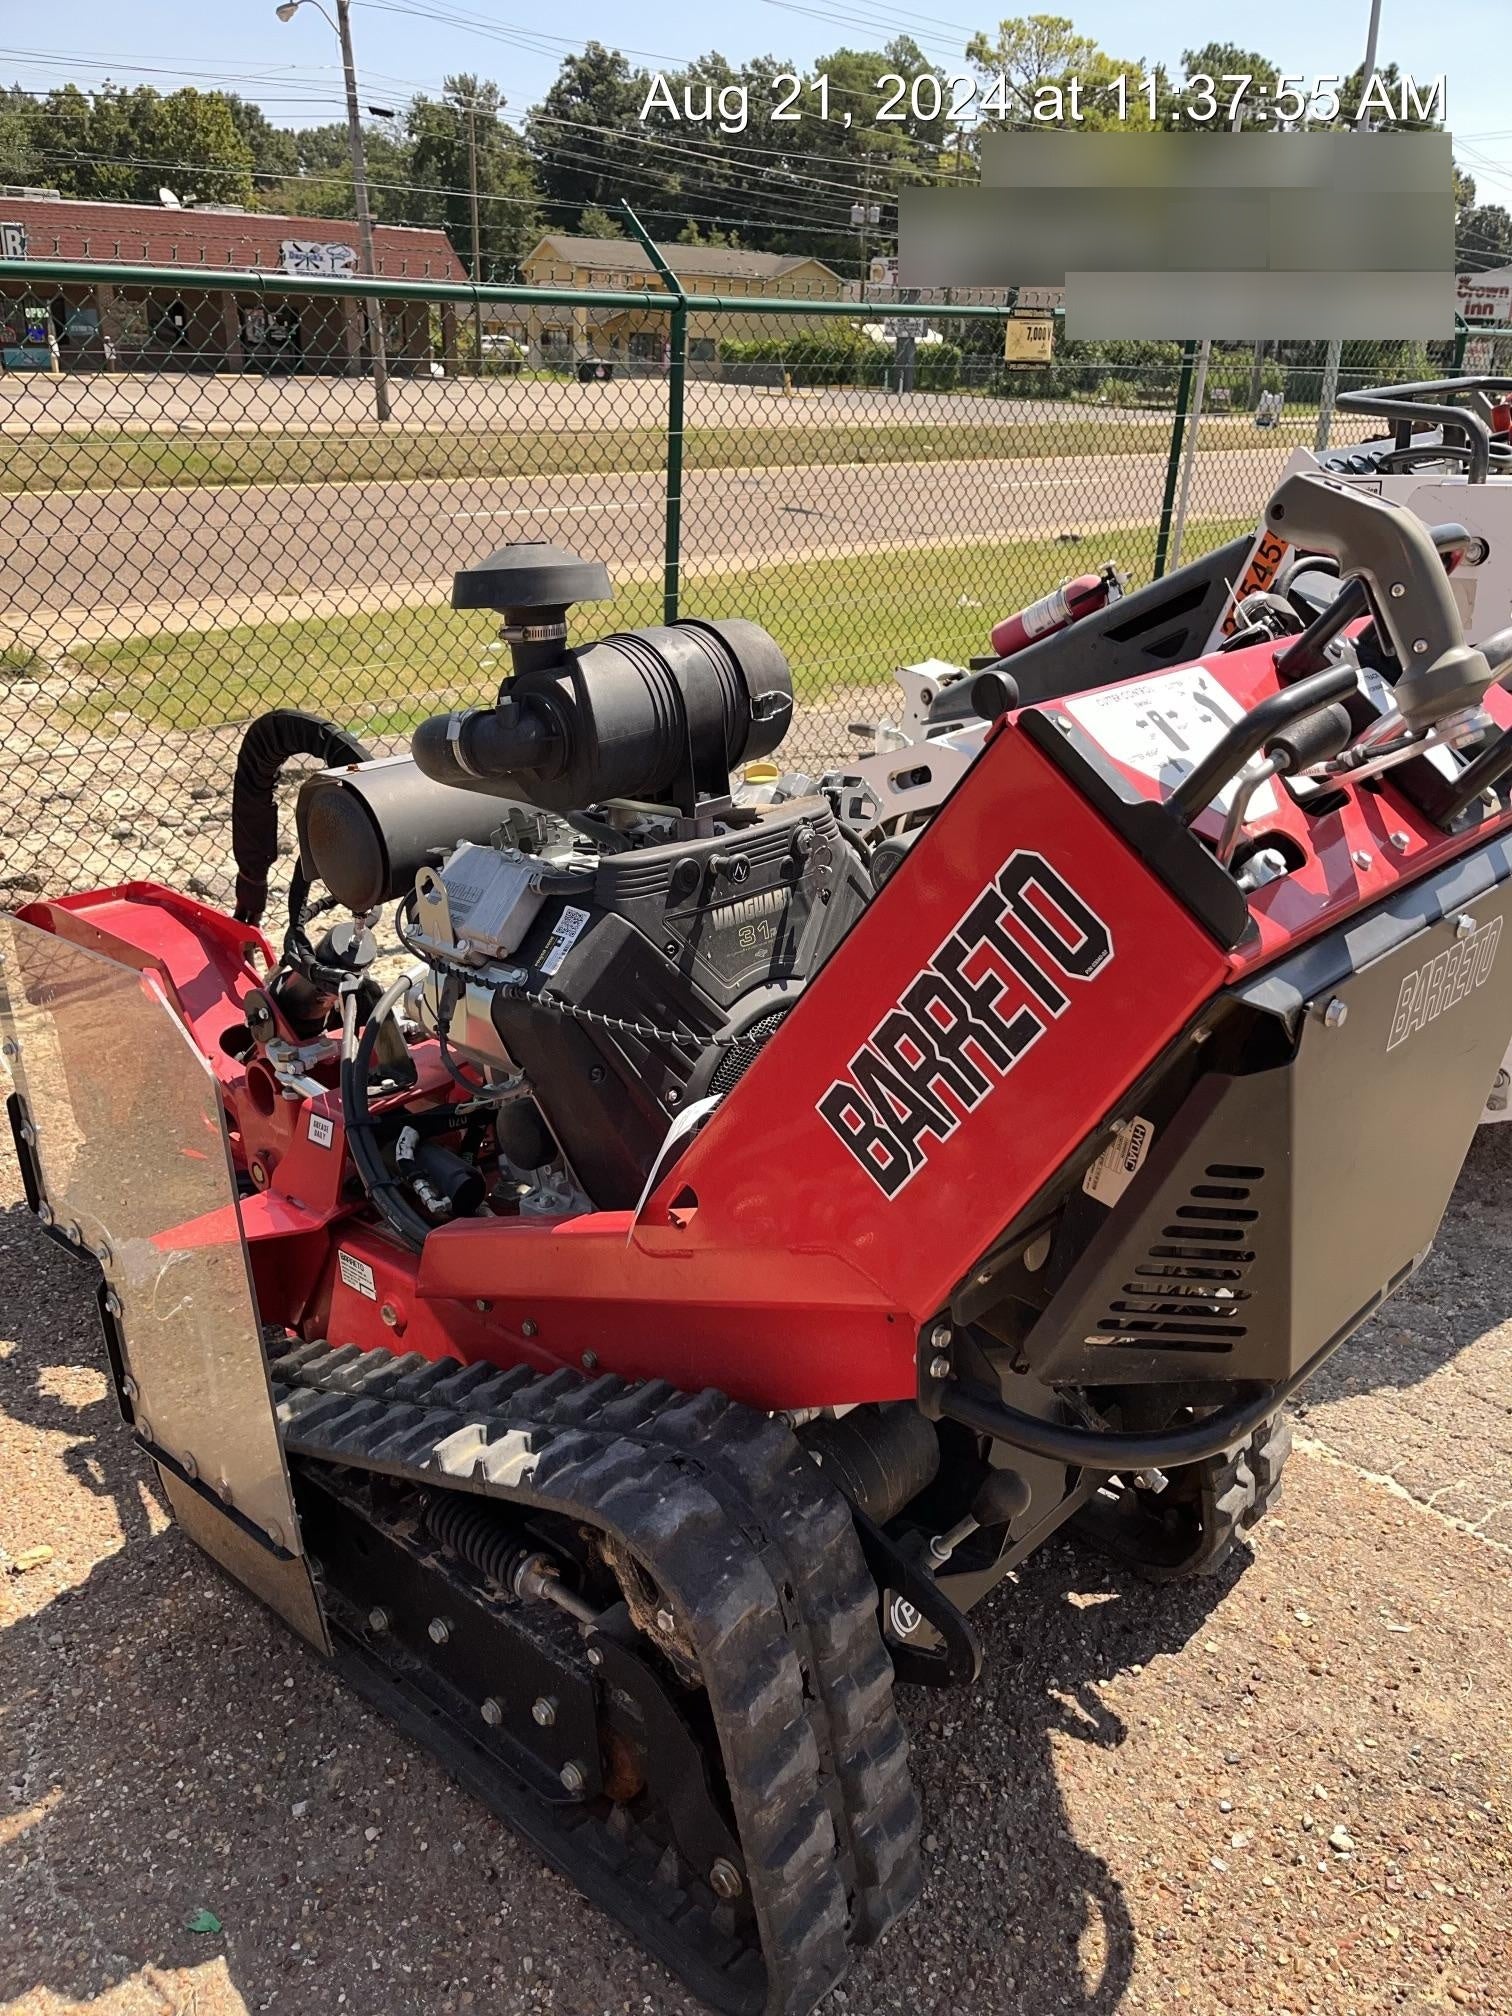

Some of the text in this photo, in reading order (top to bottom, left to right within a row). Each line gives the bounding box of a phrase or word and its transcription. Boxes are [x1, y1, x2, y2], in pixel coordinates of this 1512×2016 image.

[711, 886, 793, 932] VANGUARD
[815, 848, 1115, 1201] BARRETO
[1386, 914, 1503, 1052] BARRETO
